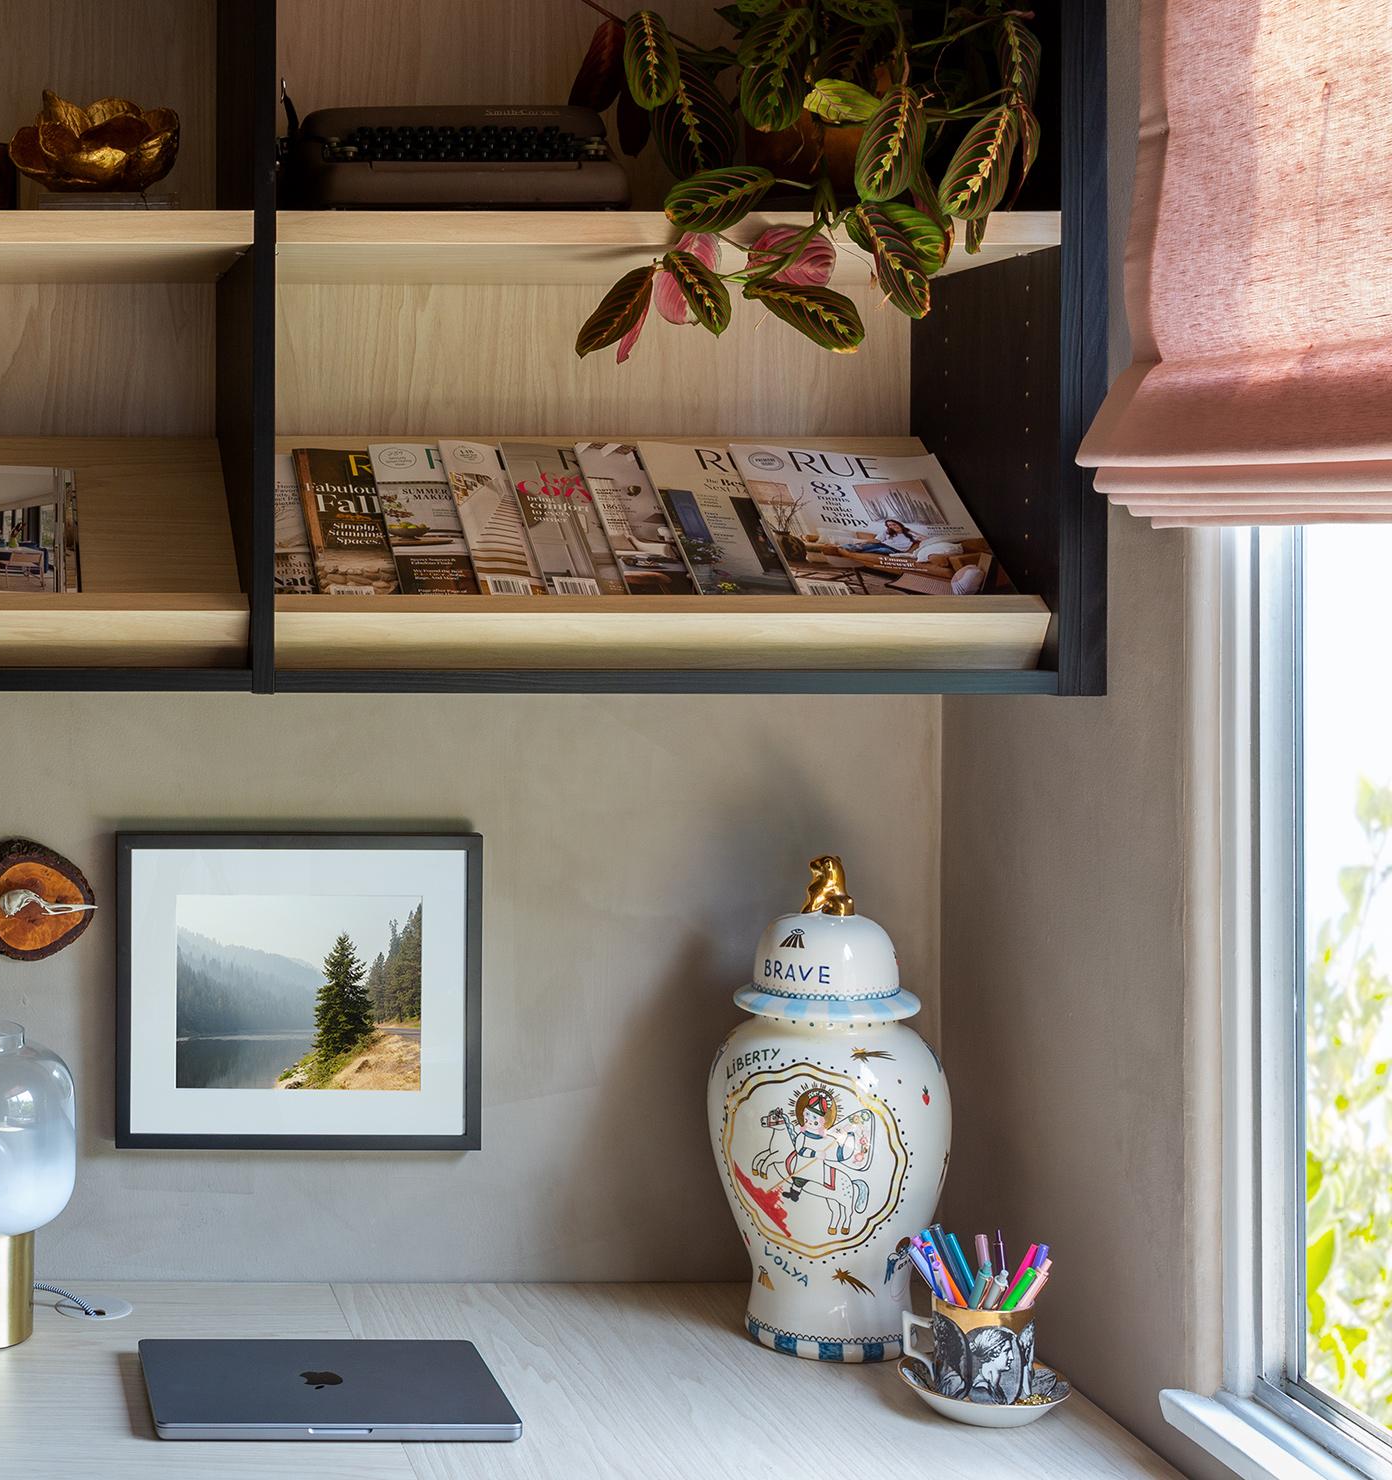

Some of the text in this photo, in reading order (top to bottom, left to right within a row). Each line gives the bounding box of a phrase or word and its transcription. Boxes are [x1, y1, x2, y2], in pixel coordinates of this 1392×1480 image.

[788, 450, 889, 480] RUE
[401, 487, 450, 496] SUMMER
[810, 481, 846, 498] 83
[315, 493, 383, 514] Fall
[529, 501, 589, 513] comfort
[821, 505, 854, 514] make
[820, 514, 870, 529] happy
[764, 958, 831, 985] BRAVE
[764, 1245, 808, 1288] LOLYA
